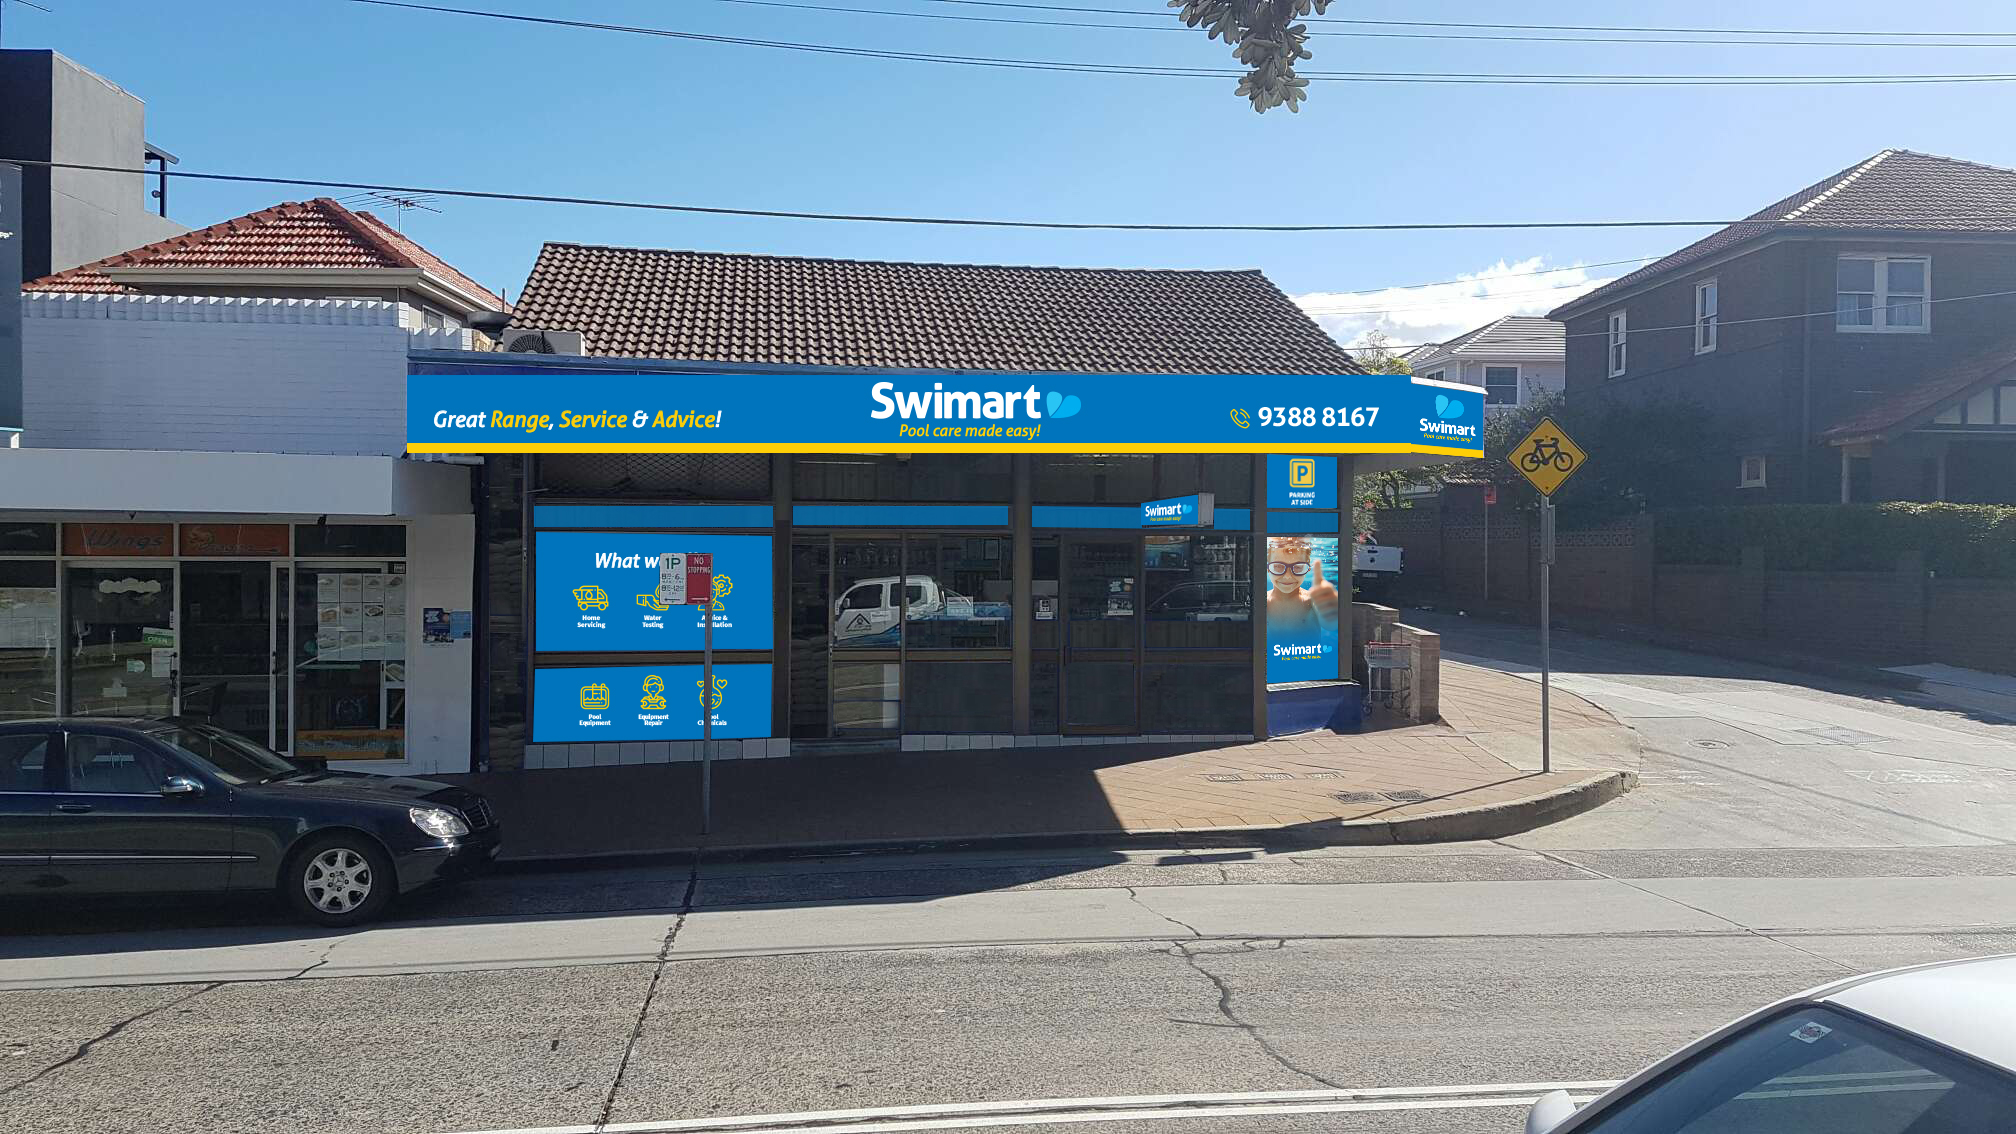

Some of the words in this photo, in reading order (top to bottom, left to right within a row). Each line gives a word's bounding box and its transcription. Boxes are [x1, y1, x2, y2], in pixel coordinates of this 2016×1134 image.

[870, 381, 1042, 420] Swimart
[433, 410, 487, 429] Great
[490, 410, 554, 433] Range,
[558, 410, 628, 429] Service
[632, 410, 649, 429] &
[651, 410, 723, 429] Advice!
[1257, 406, 1317, 427] 9388
[1321, 406, 1380, 427] 8167
[899, 424, 930, 437] Pool
[932, 427, 962, 437] care
[964, 424, 1003, 437] made
[1005, 424, 1041, 441] easy!
[1420, 418, 1476, 436] Swimart
[1297, 465, 1309, 482] P
[1288, 491, 1316, 499] PARKING
[1145, 503, 1182, 517] Swimart
[595, 552, 641, 569] What
[644, 556, 660, 569] w
[665, 557, 681, 570] 1P
[694, 556, 705, 565] NO
[577, 621, 606, 629] Servicing
[642, 621, 664, 629] Testing
[1274, 643, 1322, 656] Swimart
[579, 719, 612, 727] Equipment
[638, 713, 669, 721] Equipment
[643, 719, 663, 727] Repair
